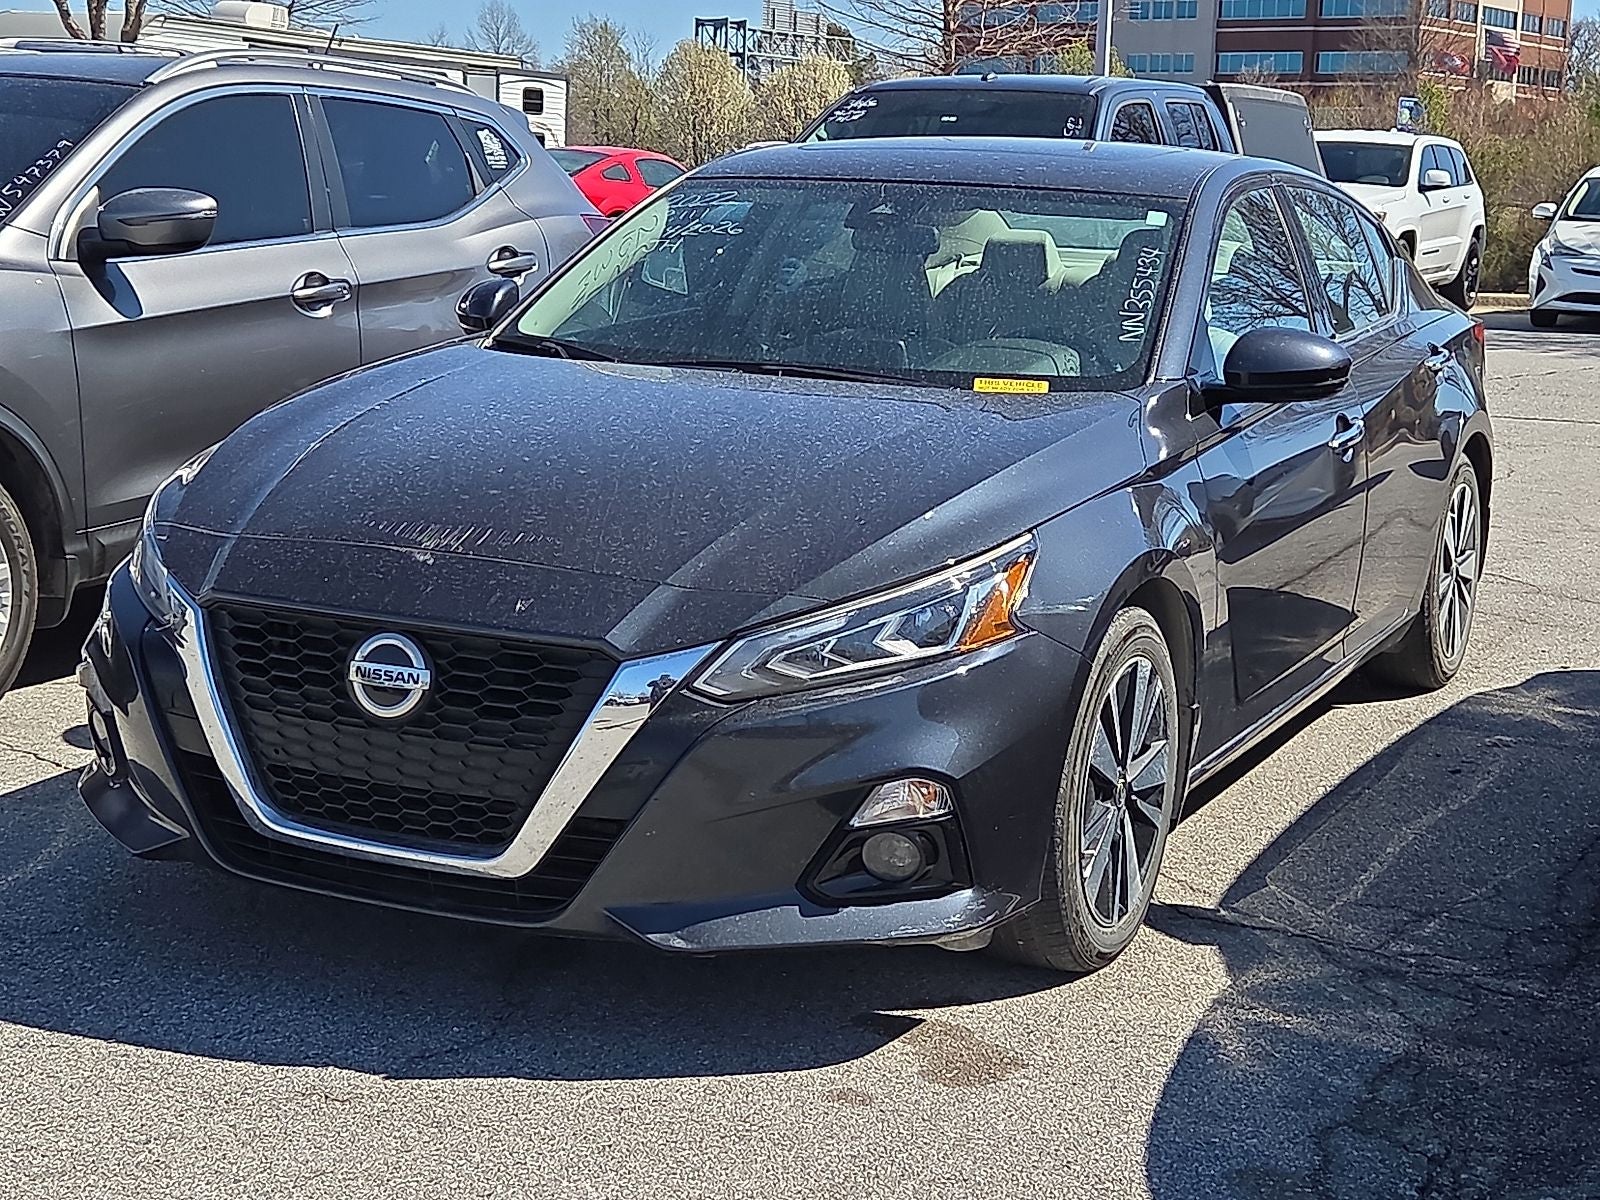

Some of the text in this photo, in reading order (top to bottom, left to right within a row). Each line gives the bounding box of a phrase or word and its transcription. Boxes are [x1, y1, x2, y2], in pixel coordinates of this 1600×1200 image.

[1118, 246, 1166, 342] NN355434
[1002, 380, 1043, 389] VEHICLE
[355, 665, 420, 685] NISSAN
